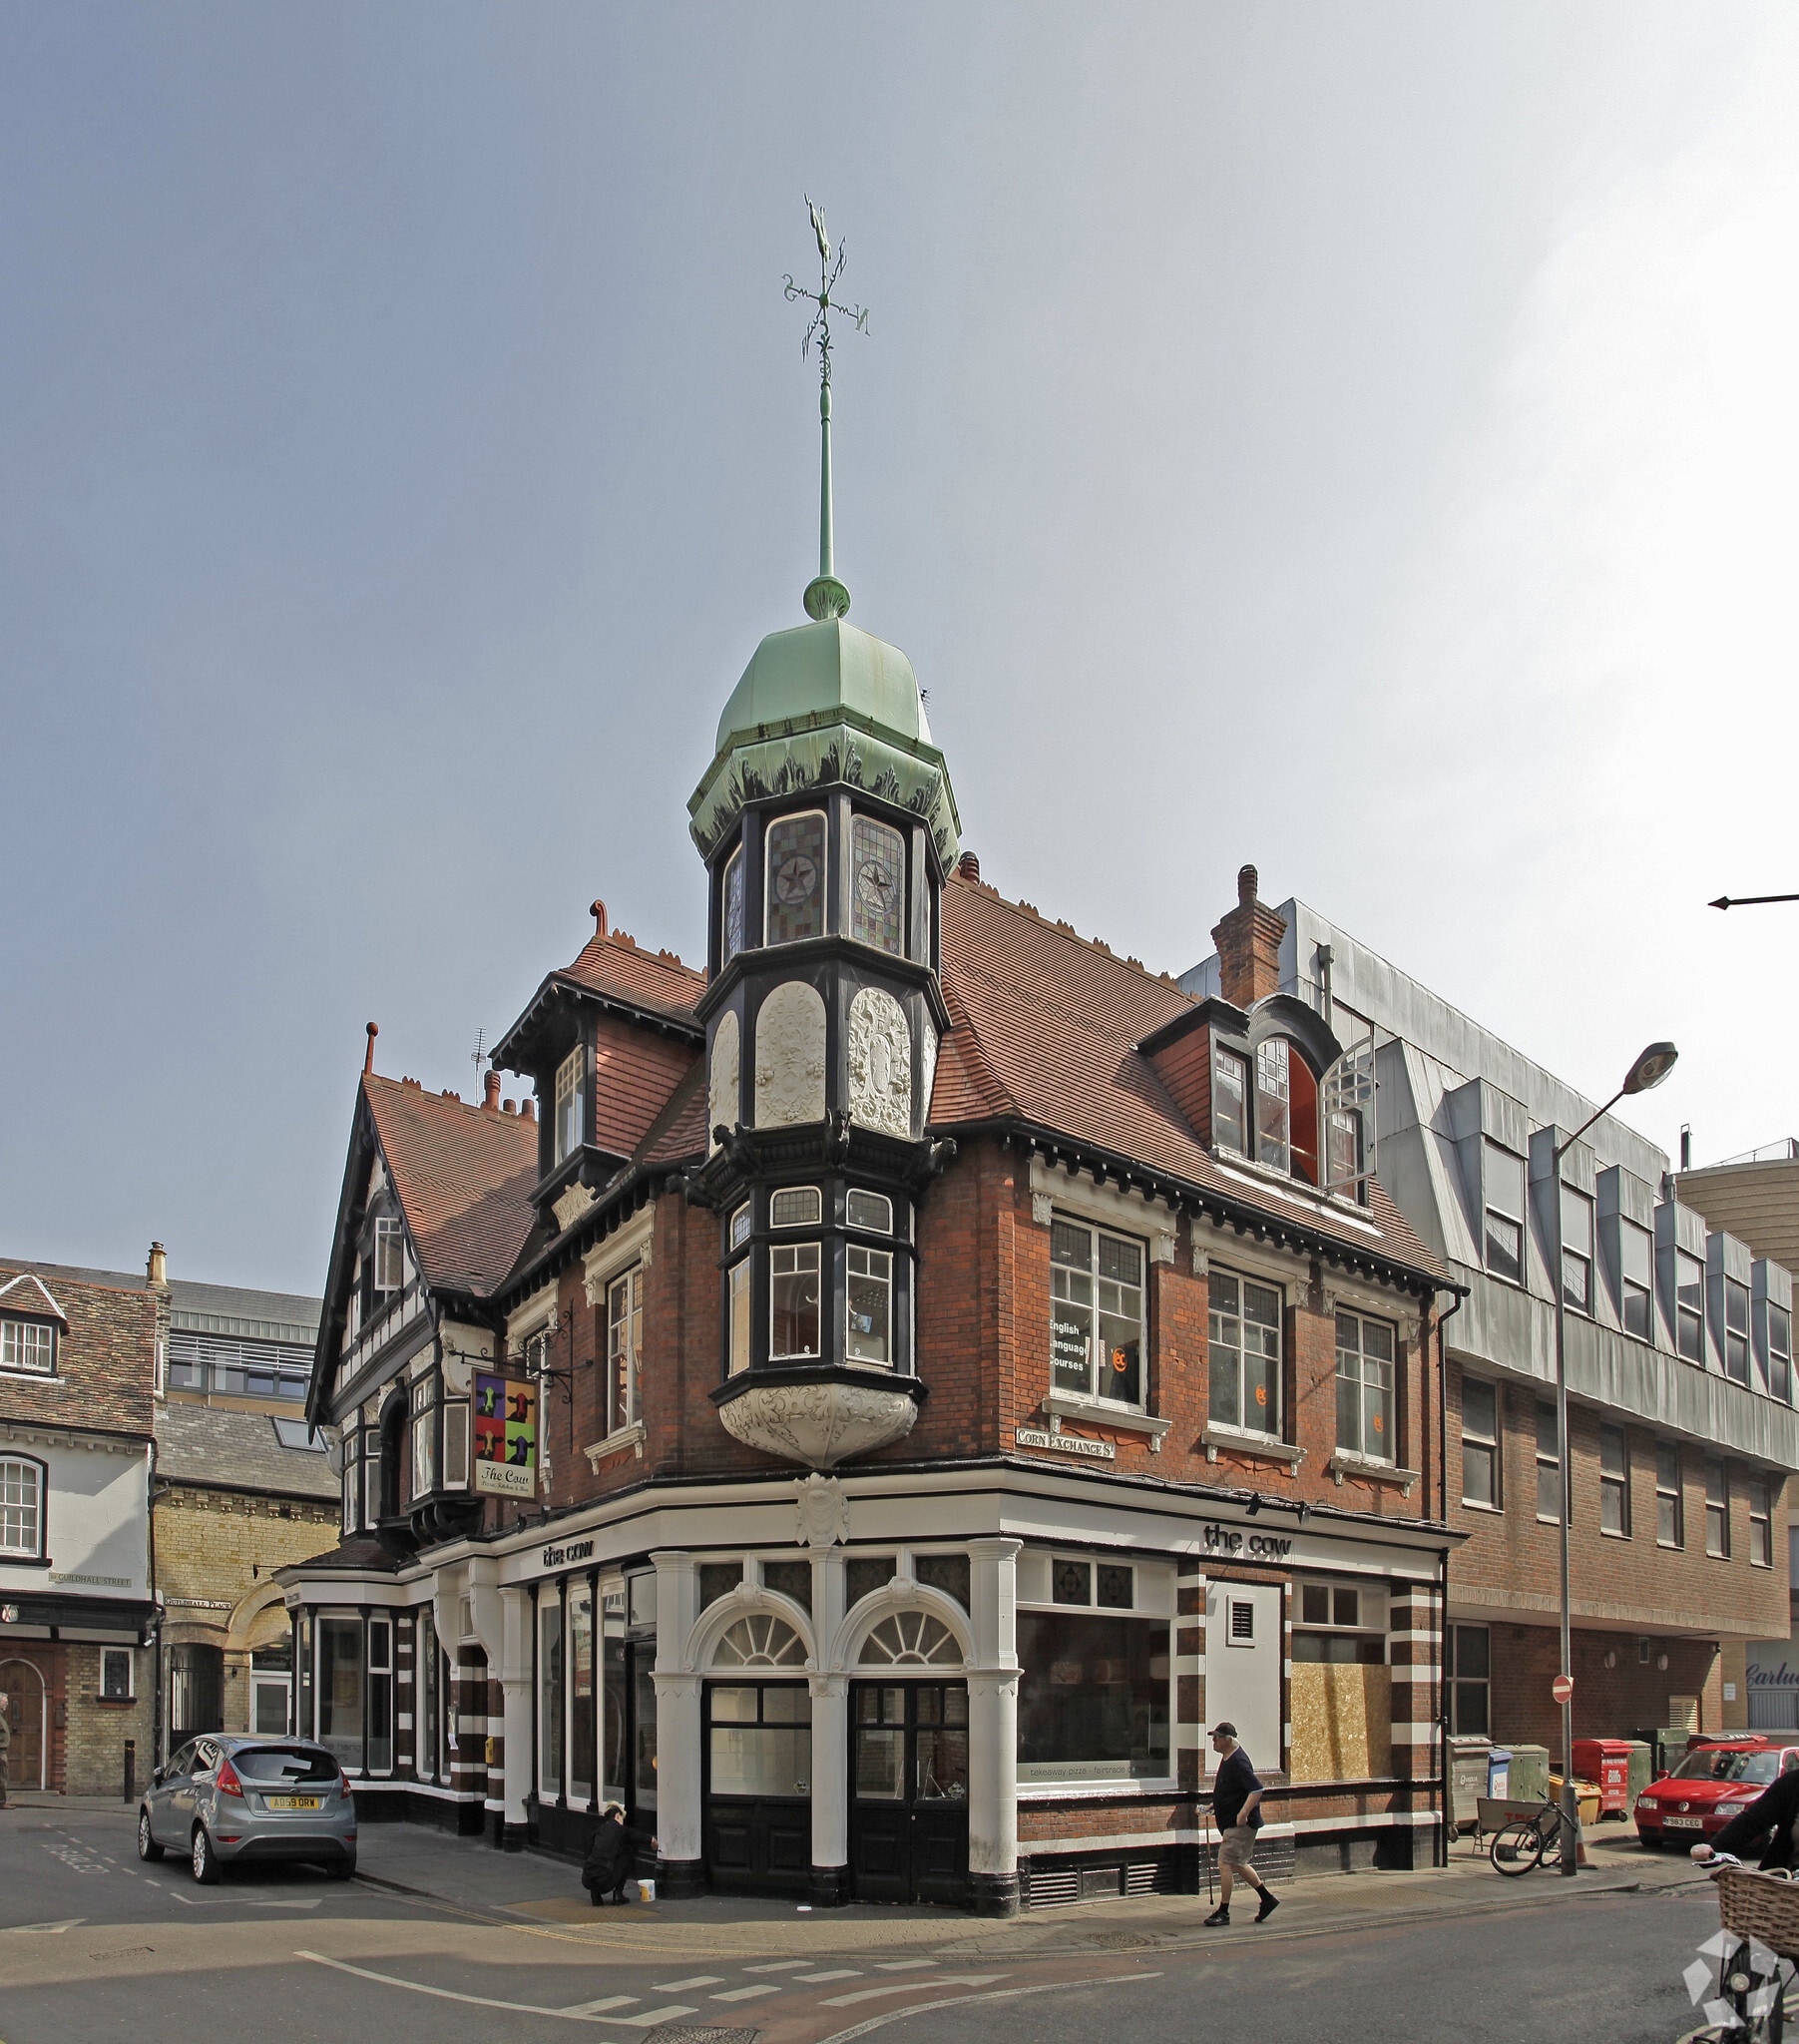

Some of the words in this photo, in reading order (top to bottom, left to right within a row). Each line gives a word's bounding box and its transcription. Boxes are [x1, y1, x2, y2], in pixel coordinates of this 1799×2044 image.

[1050, 1339, 1088, 1356] anguag
[1018, 1429, 1046, 1446] CORN
[1049, 1434, 1102, 1454] EXCHANGE
[481, 1466, 502, 1481] The
[505, 1469, 529, 1484] Cow
[1203, 1524, 1243, 1550] the
[1248, 1535, 1292, 1555] cow
[543, 1546, 565, 1567] the
[566, 1540, 595, 1561] cow
[58, 1573, 100, 1584] GUILDHALL
[103, 1577, 130, 1586] STREET
[1030, 1768, 1066, 1777] takeaway
[1094, 1766, 1125, 1775] fairtrade
[274, 1797, 297, 1807] AD59
